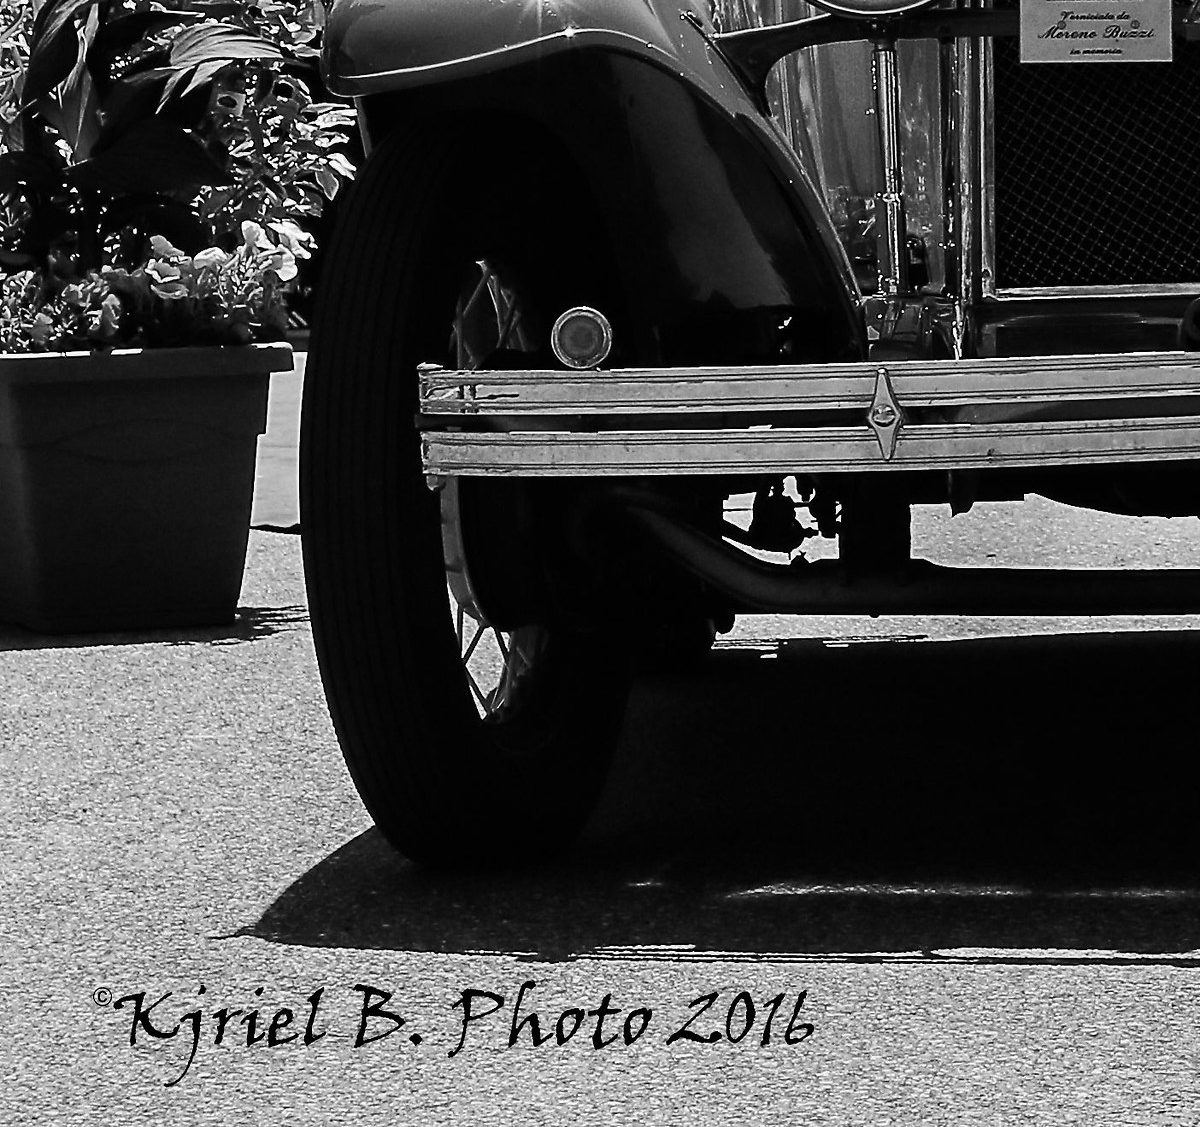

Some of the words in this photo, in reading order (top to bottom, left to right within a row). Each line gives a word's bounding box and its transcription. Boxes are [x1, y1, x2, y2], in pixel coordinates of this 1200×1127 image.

[1060, 11, 1115, 22] Verniciata
[1116, 11, 1131, 20] da
[1038, 25, 1098, 39] Moreno
[1104, 25, 1155, 39] Buzzi
